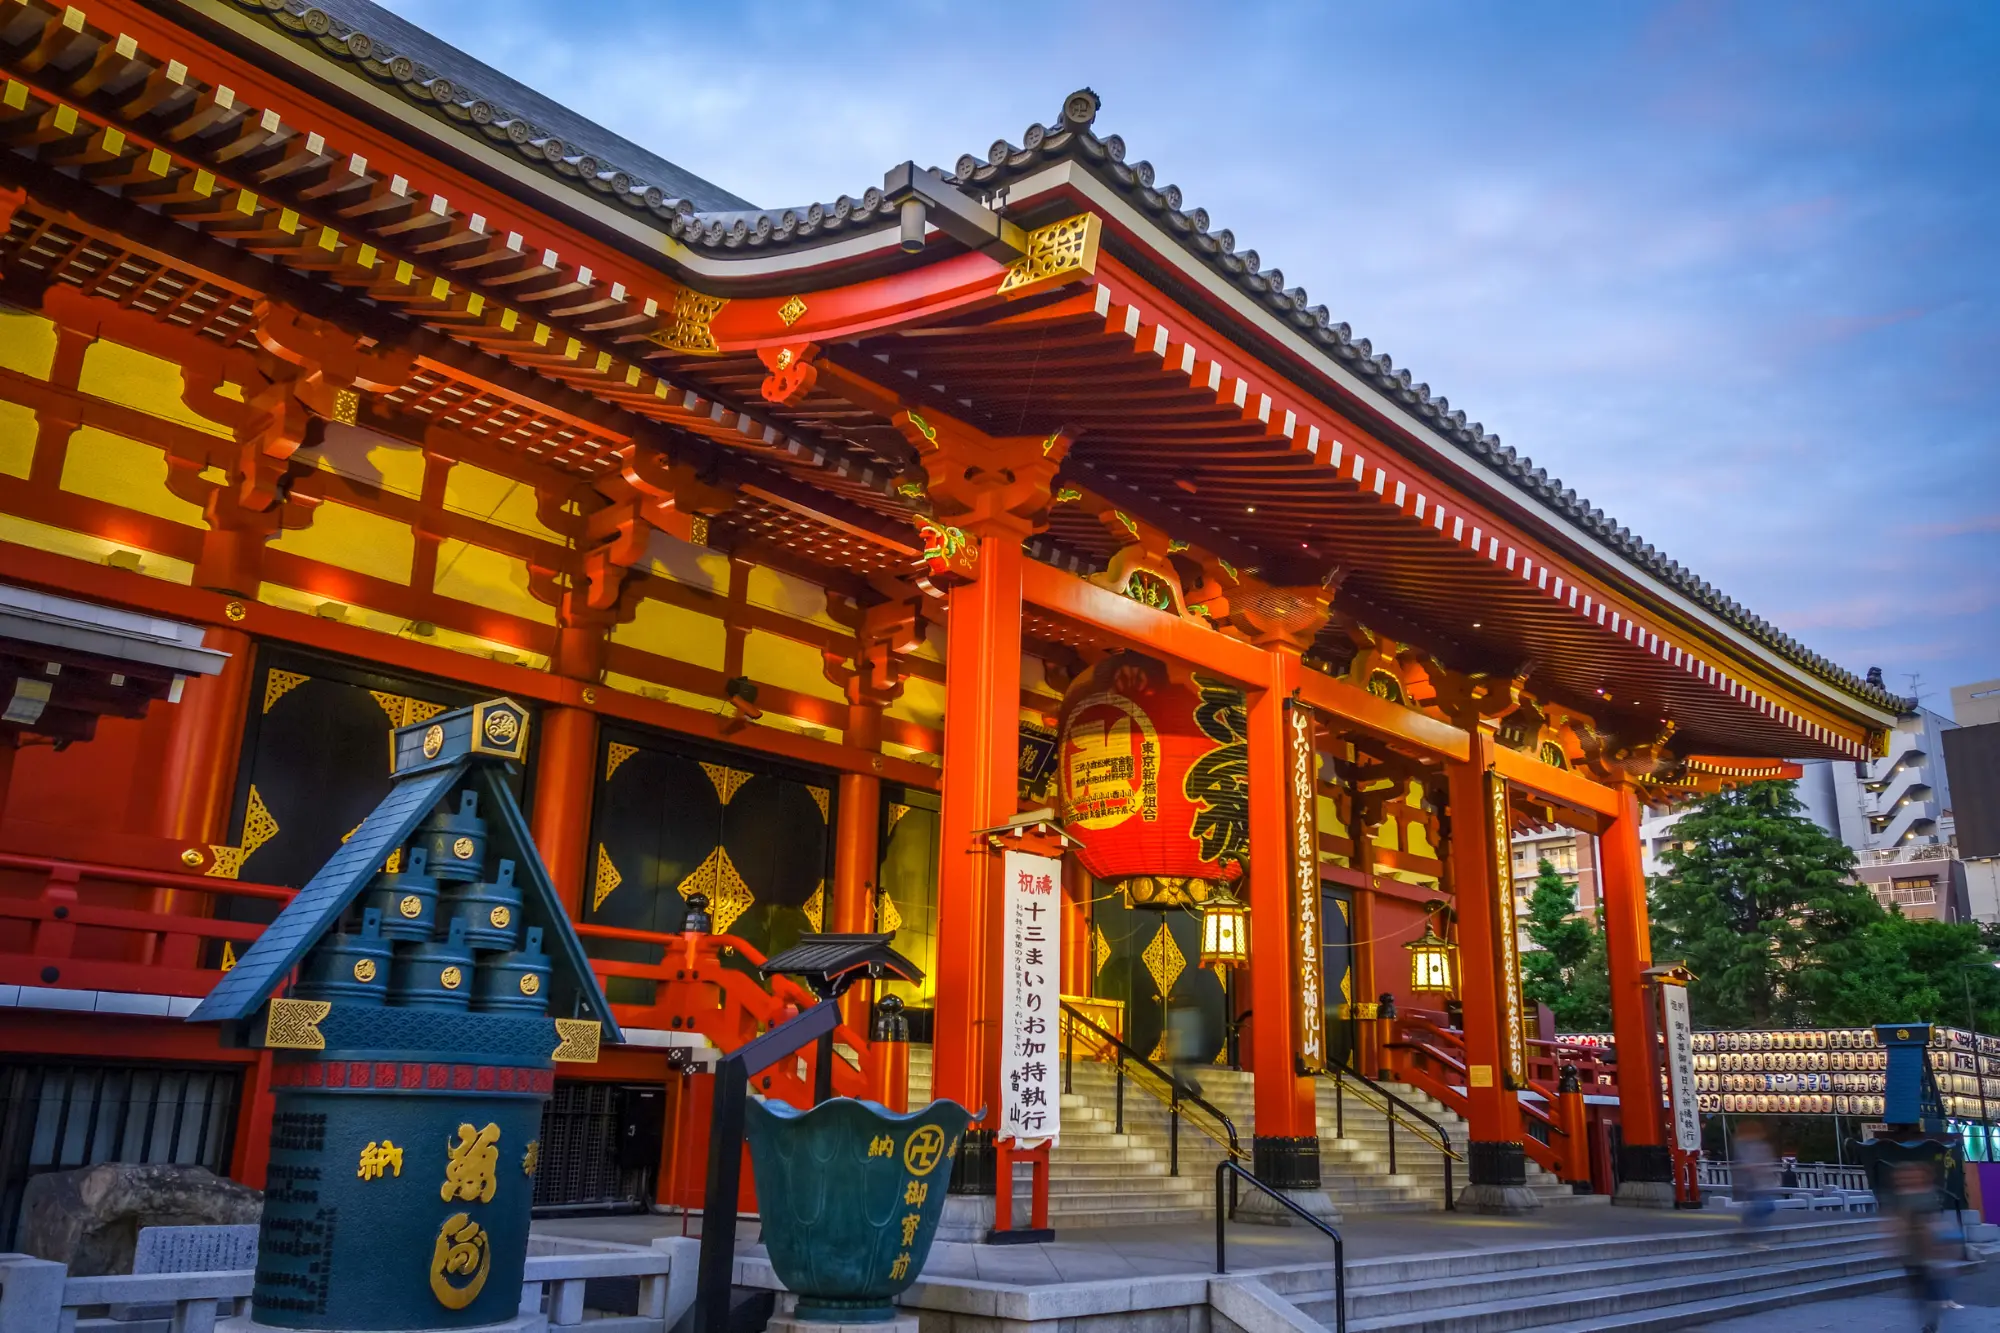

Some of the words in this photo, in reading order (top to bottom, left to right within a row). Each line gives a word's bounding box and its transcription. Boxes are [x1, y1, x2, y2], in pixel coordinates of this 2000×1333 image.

[1142, 741, 1157, 822] 東京新橋組合
[1021, 902, 1047, 1131] 十三まいりお加持執行
